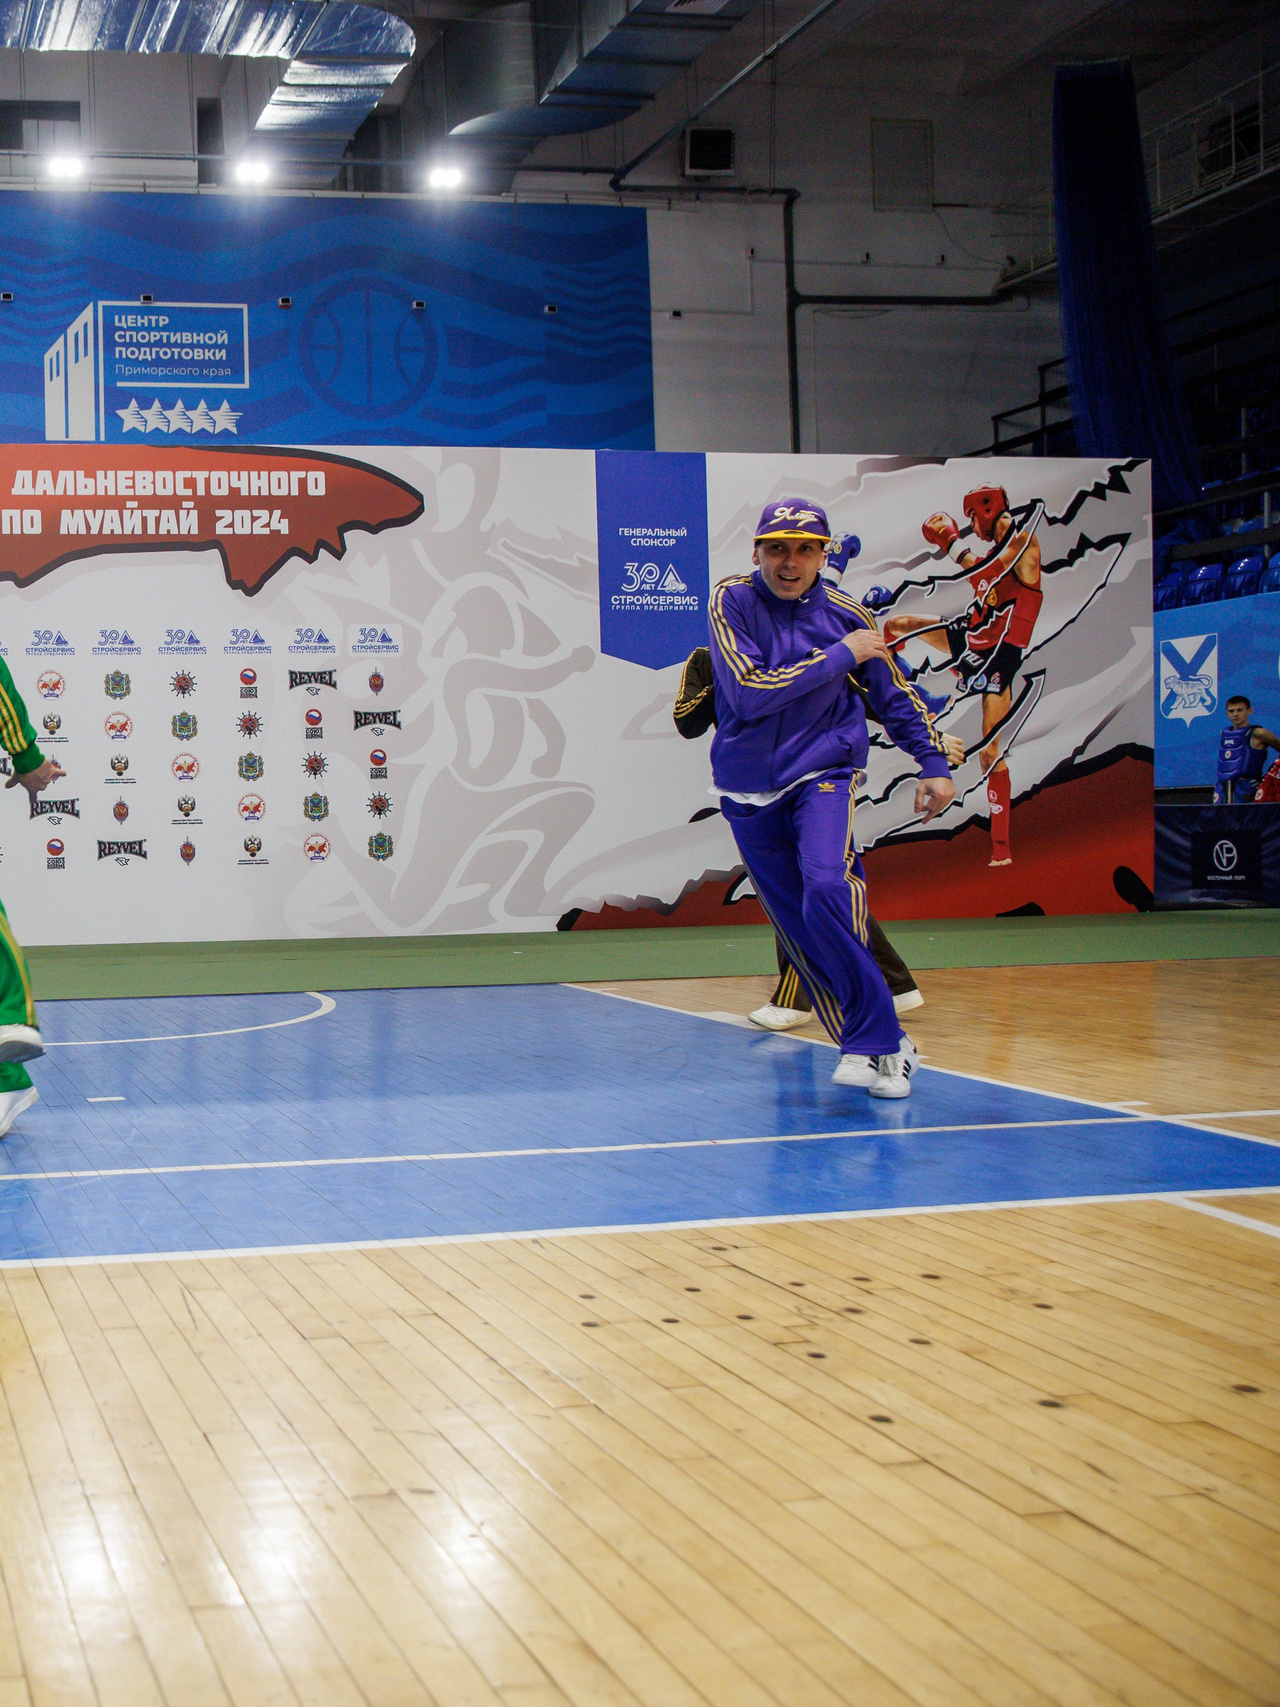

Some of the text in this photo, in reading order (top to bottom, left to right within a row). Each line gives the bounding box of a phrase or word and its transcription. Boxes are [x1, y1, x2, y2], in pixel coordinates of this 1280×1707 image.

[114, 315, 169, 328] ЦЕНТР
[114, 330, 229, 345] СПОРТИВНОЙ
[115, 347, 227, 361] ПОДГОТОВКИ
[116, 364, 231, 377] Приморского края
[11, 470, 326, 496] ДАЛЬНЕВОСТОЧНОГО
[1, 509, 42, 534] ПО
[60, 501, 198, 535] МУАЙТАЙ
[215, 509, 289, 535] 2024
[619, 527, 687, 537] ГЕНЕРАЛЬНЫЙ
[631, 538, 676, 546] СПОНСОР
[611, 594, 698, 605] СТРОЙСЕРВИС
[288, 669, 337, 691] REYVEL
[353, 710, 401, 731] REYVEL
[29, 800, 80, 820] REYVEL
[97, 840, 147, 861] REYVEL
